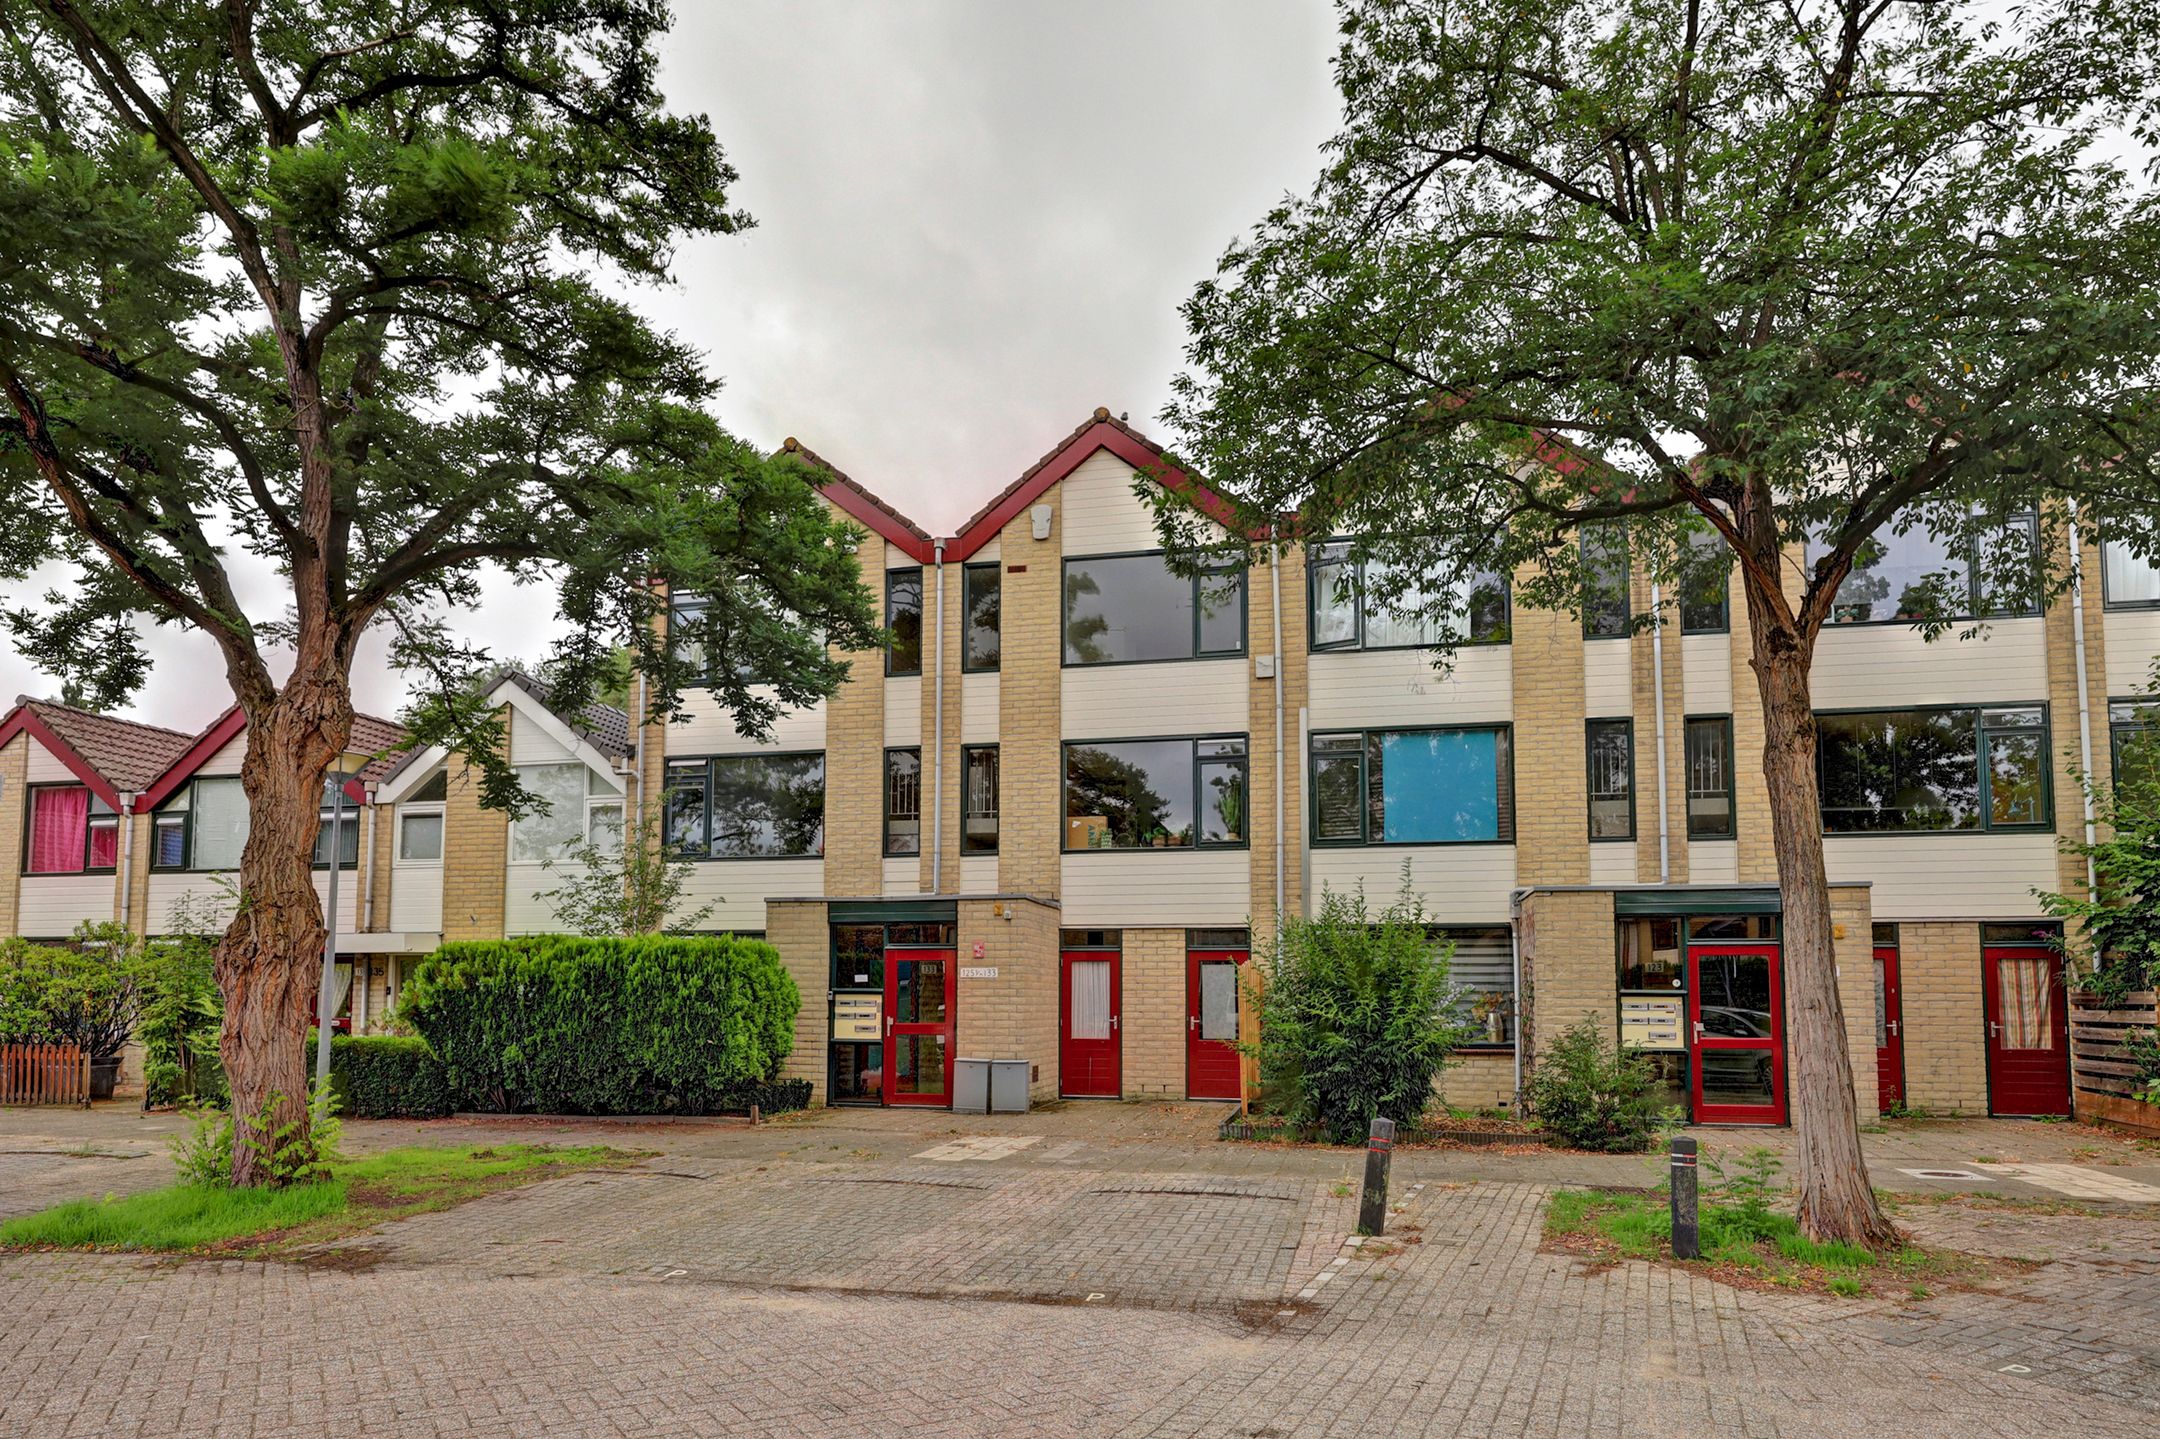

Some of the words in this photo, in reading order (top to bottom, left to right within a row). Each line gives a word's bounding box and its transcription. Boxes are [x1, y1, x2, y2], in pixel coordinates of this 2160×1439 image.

[923, 965, 935, 973] 133
[1647, 963, 1663, 972] 123
[663, 1269, 688, 1277] P
[1086, 1292, 1105, 1301] P
[1997, 1364, 2031, 1372] P
